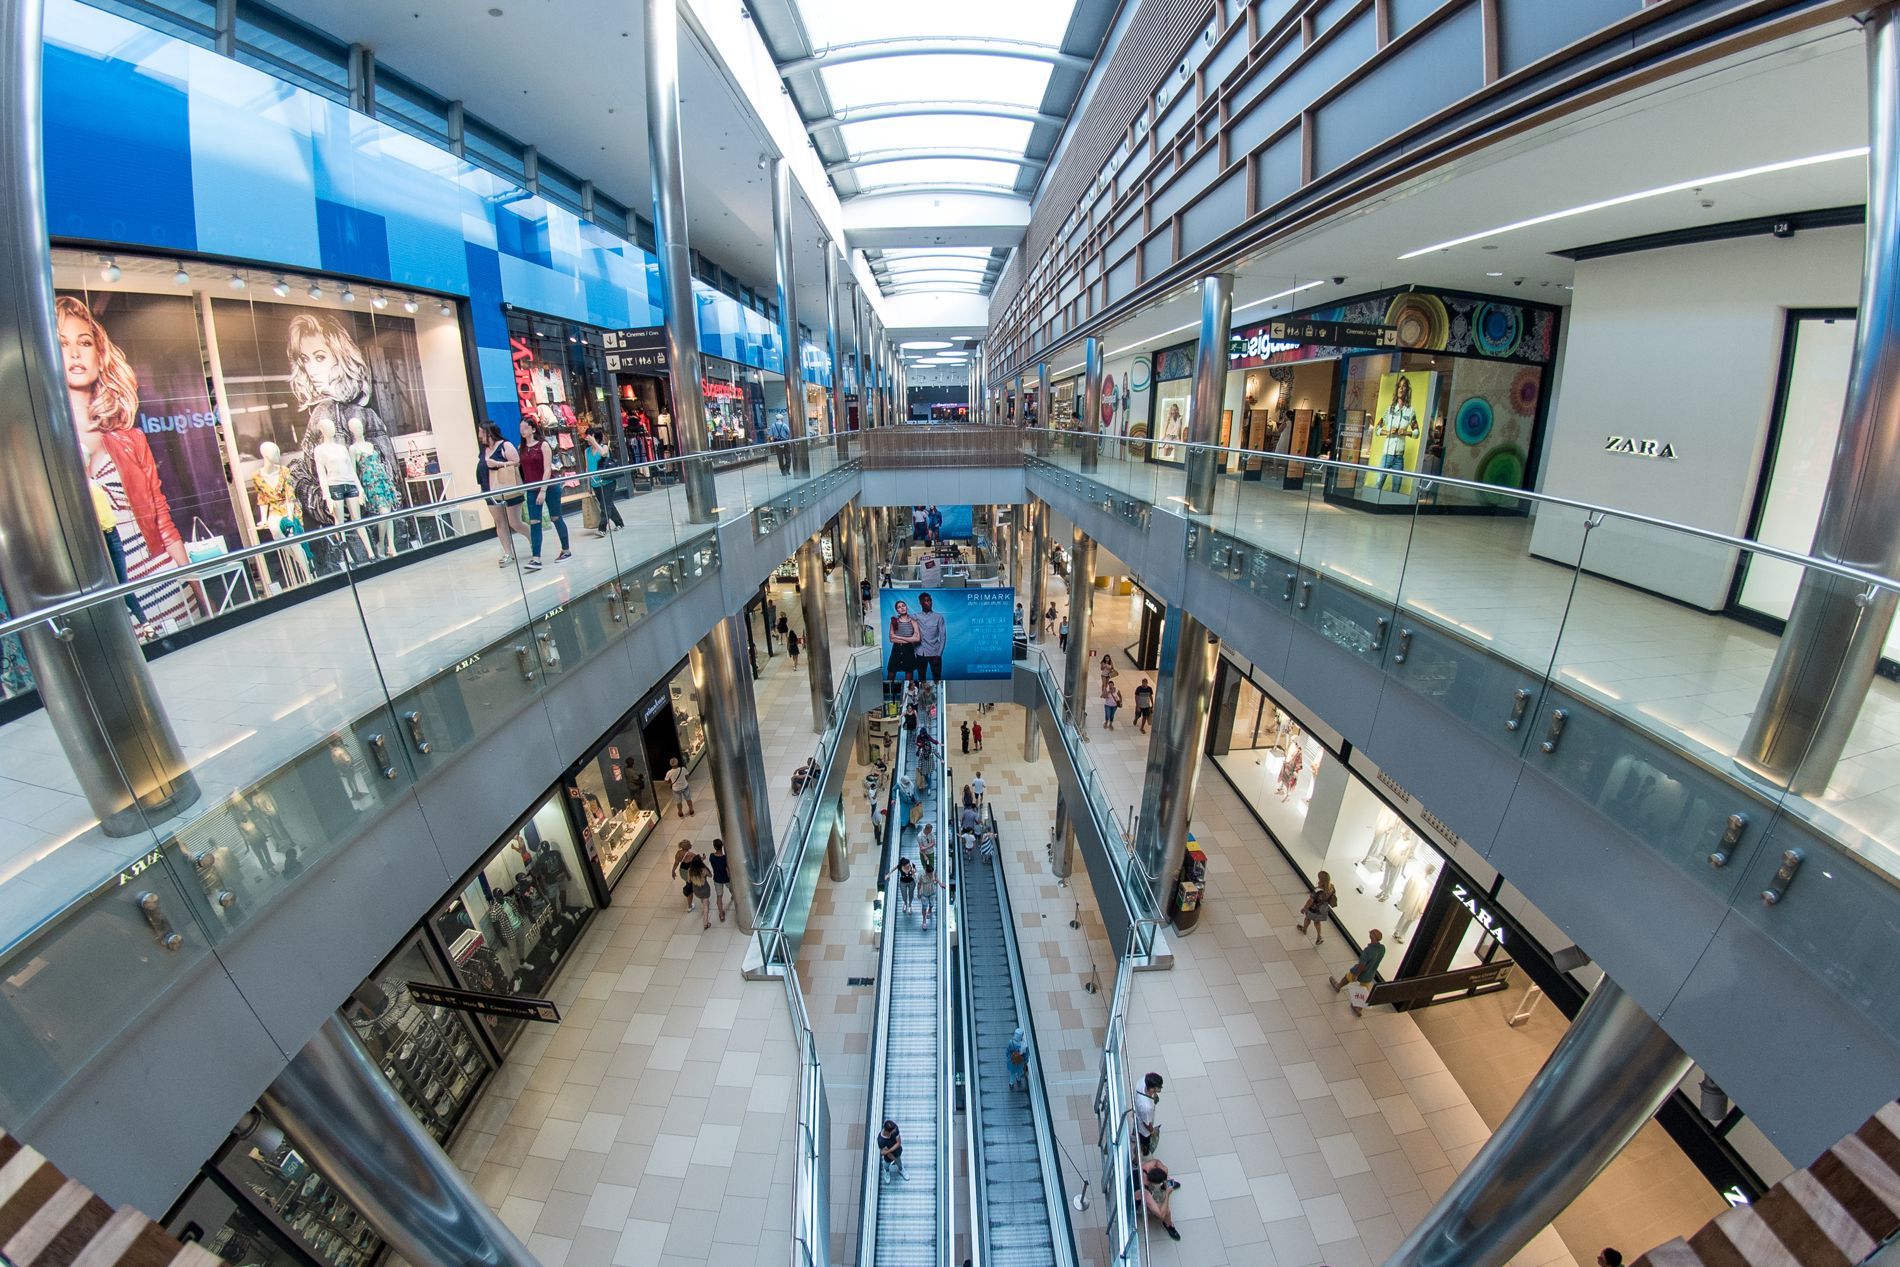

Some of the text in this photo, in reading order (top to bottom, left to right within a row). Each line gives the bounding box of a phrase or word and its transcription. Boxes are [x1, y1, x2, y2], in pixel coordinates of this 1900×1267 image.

[1605, 435, 1679, 460] ZARA
[967, 593, 1010, 601] PRIMARK
[1451, 883, 1506, 945] ZARA
